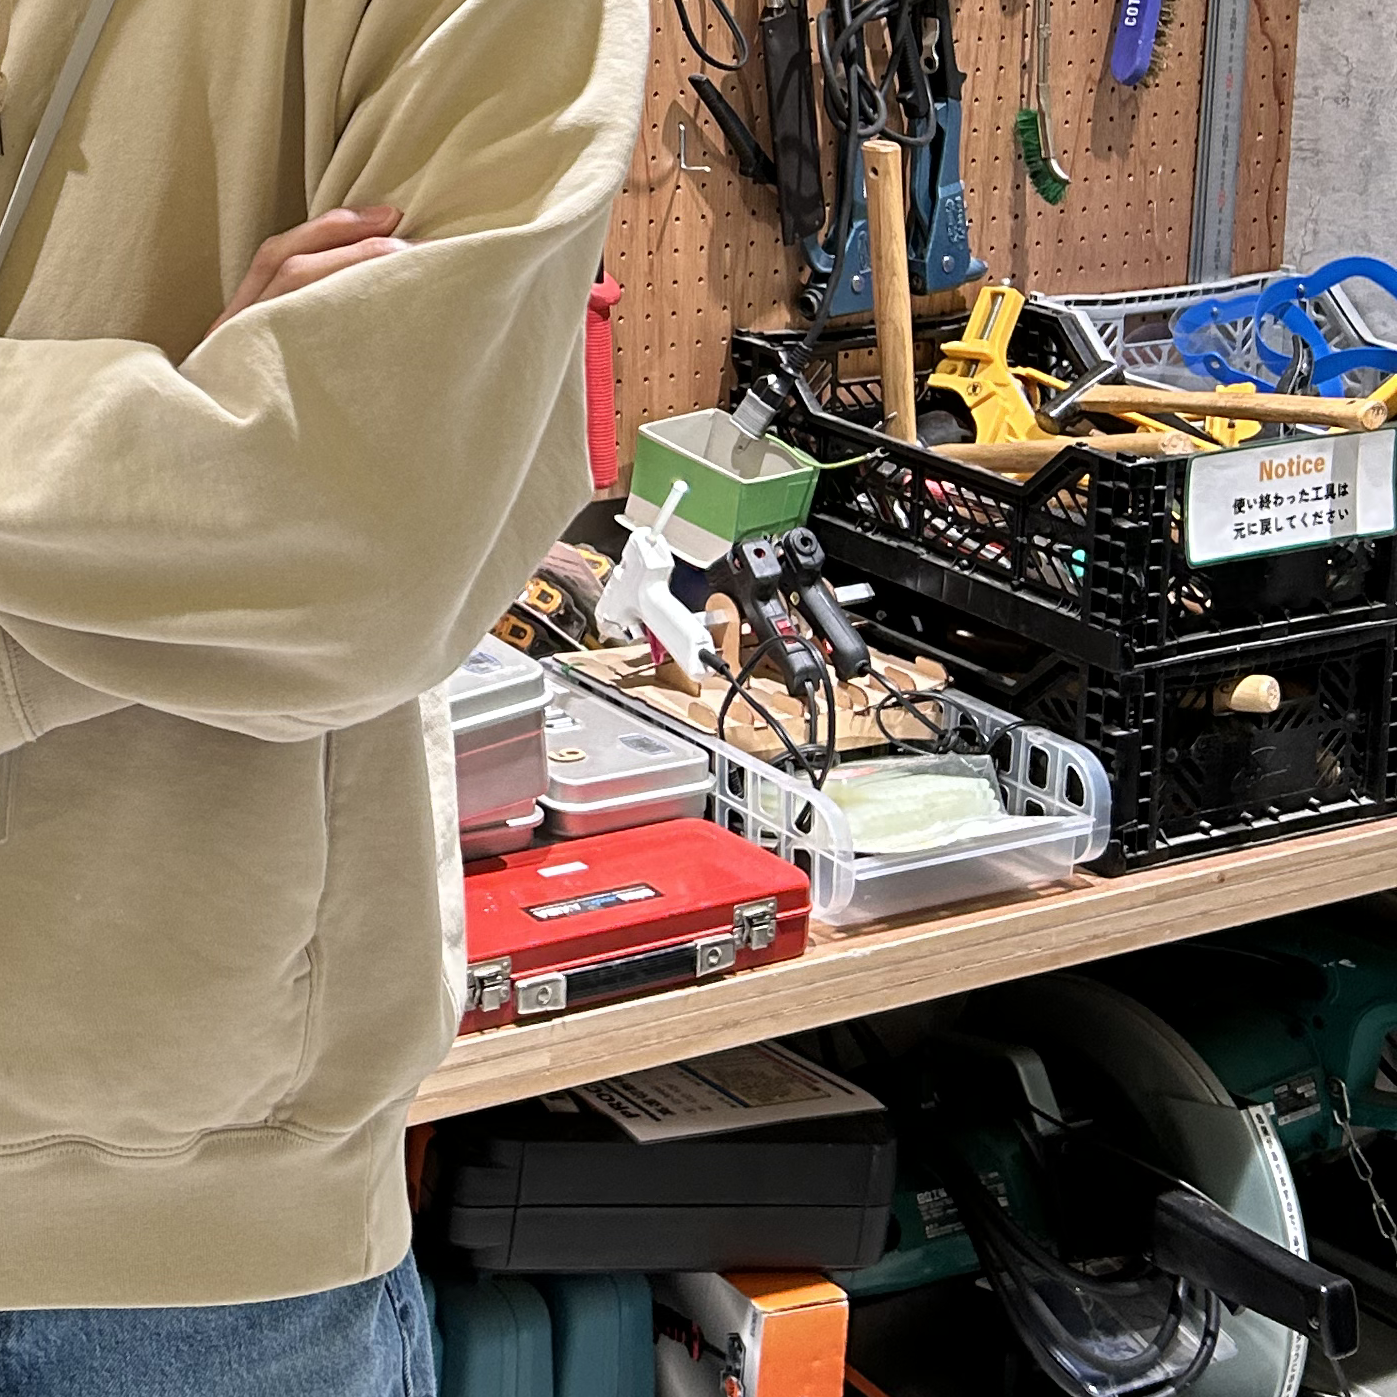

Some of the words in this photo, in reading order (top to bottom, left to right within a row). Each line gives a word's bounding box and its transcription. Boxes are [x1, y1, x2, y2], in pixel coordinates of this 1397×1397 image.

[1259, 454, 1325, 482] Notice
[1233, 482, 1349, 515] 使い終わった工具は
[1233, 508, 1349, 540] 元に戻してください
